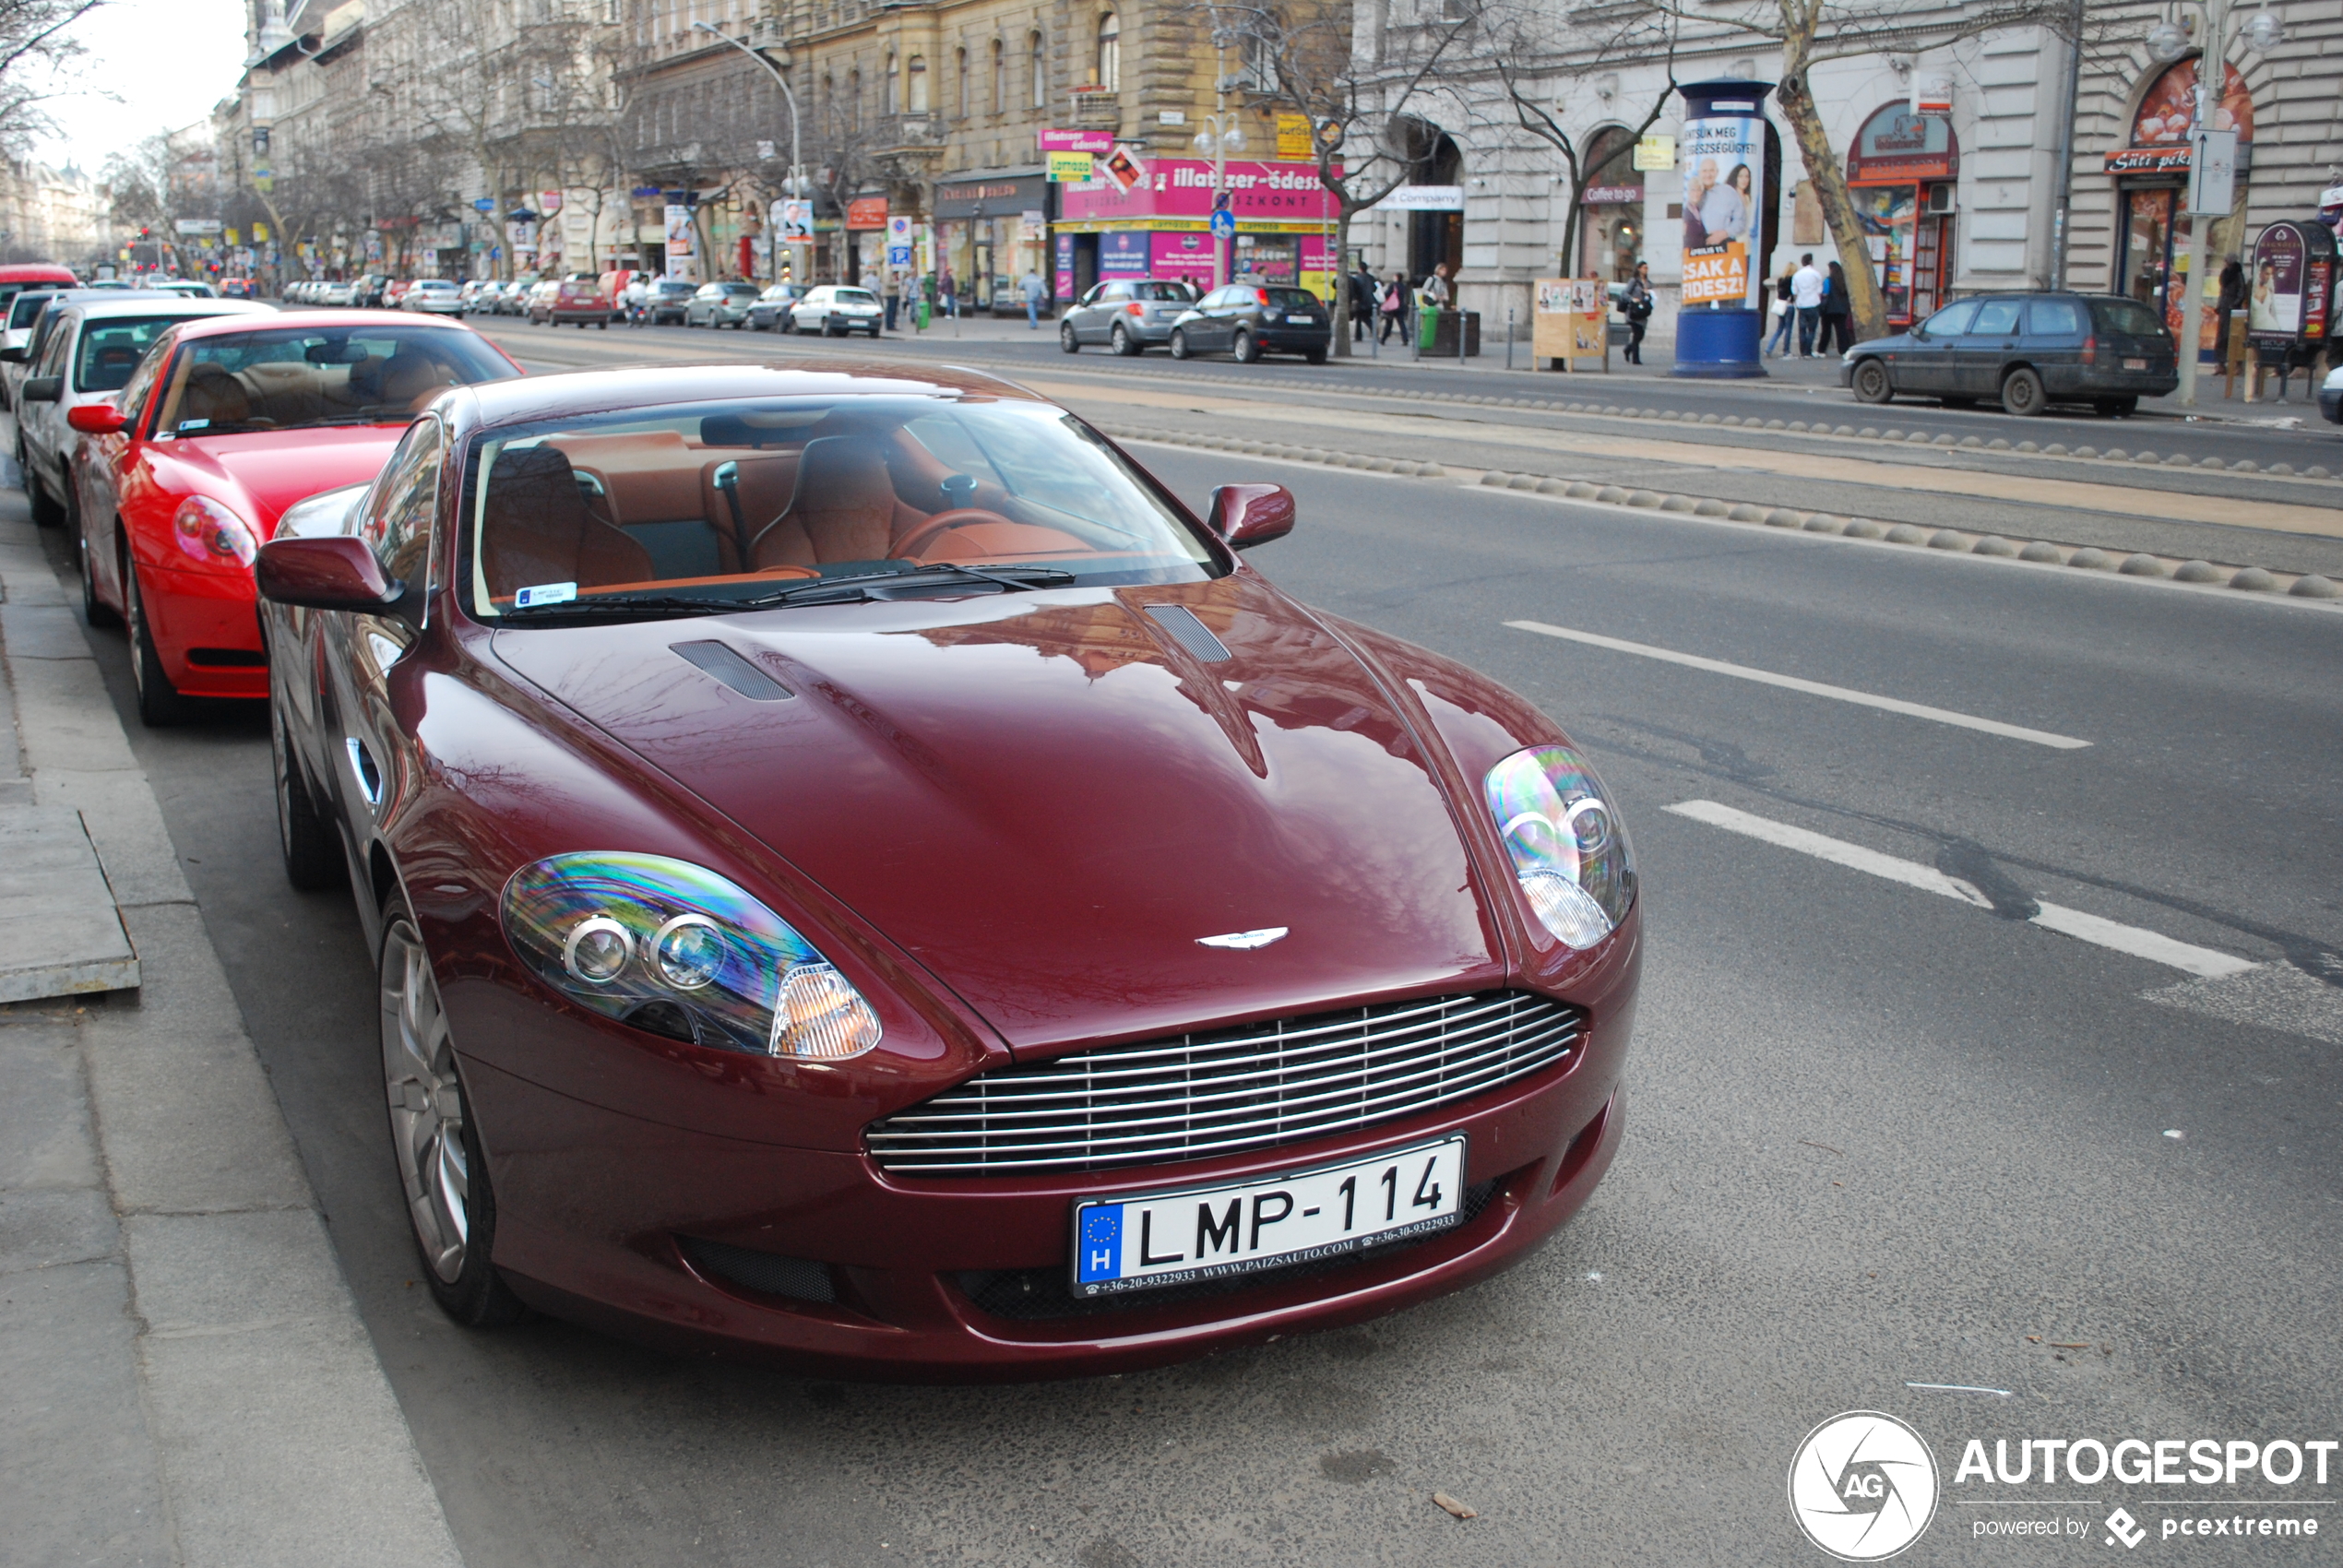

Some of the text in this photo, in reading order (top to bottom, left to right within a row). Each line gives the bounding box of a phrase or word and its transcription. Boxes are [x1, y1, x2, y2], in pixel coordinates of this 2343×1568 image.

[1044, 131, 1085, 141] illatszer
[1715, 127, 1736, 137] MEG
[1072, 139, 1109, 150] édesség
[2109, 152, 2151, 172] Süti
[1173, 167, 1321, 190] illatzer-édess
[1235, 196, 1308, 207] SZKONT
[1399, 193, 1457, 203] Company
[1587, 187, 1636, 202] Coffee to go
[1729, 257, 1742, 275] A
[1683, 277, 1744, 300] FIDESZ!
[1140, 1155, 1442, 1267] LMP-114
[1091, 1249, 1111, 1271] H
[1101, 1215, 1455, 1292] +36-20-9322933 WWW.PAIZSAUTO.COM +36-30-9322933
